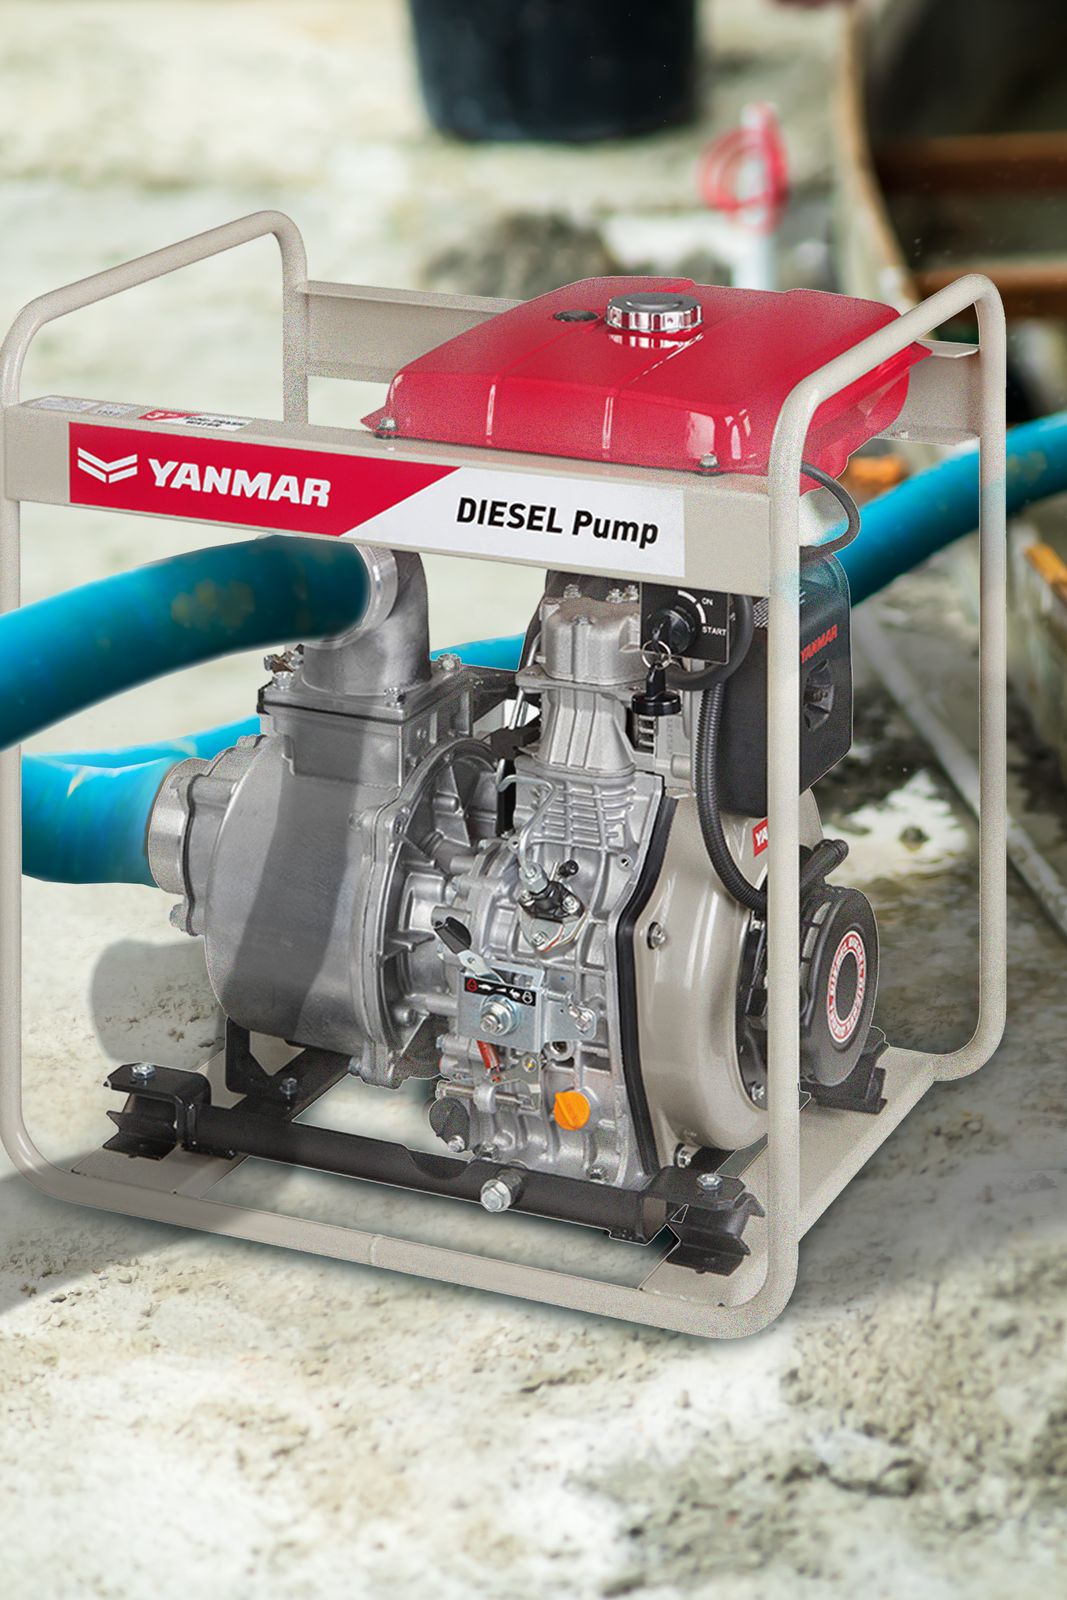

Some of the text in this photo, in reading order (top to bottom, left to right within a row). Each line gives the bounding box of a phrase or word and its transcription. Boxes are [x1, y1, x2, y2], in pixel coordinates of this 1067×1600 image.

[149, 458, 331, 507] YANMAR
[456, 497, 659, 549] DIESEL Pump
[701, 597, 714, 605] ON
[702, 626, 727, 636] START
[800, 624, 838, 665] YANMAR
